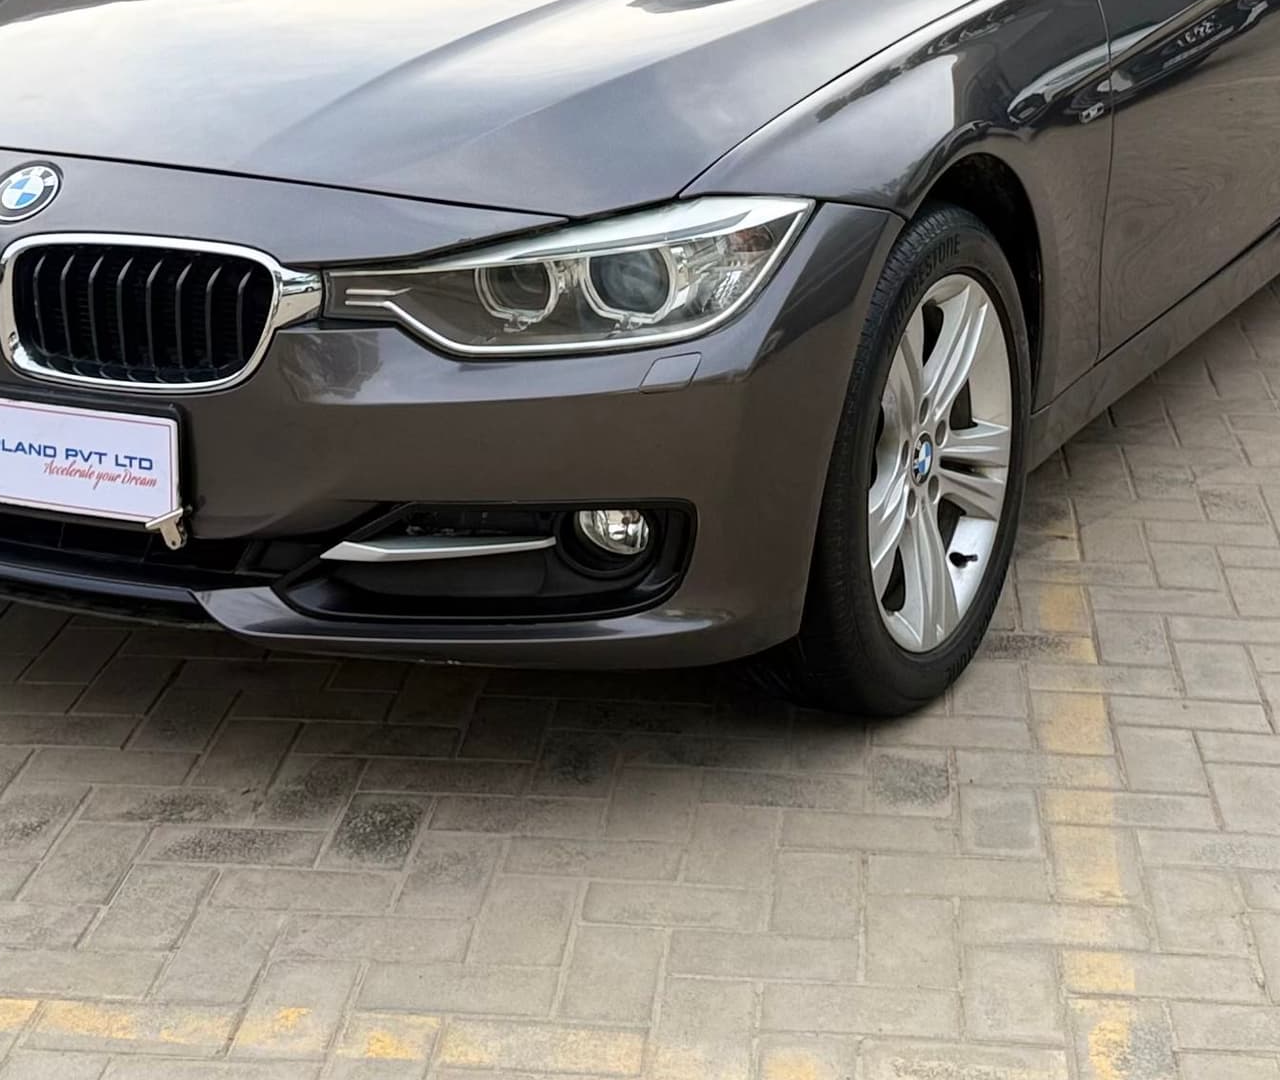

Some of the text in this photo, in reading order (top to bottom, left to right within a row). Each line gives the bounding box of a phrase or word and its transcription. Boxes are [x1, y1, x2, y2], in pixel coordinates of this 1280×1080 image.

[65, 447, 108, 465] PVT
[115, 454, 153, 471] LTD
[43, 459, 158, 490] Accelerate your Dream
